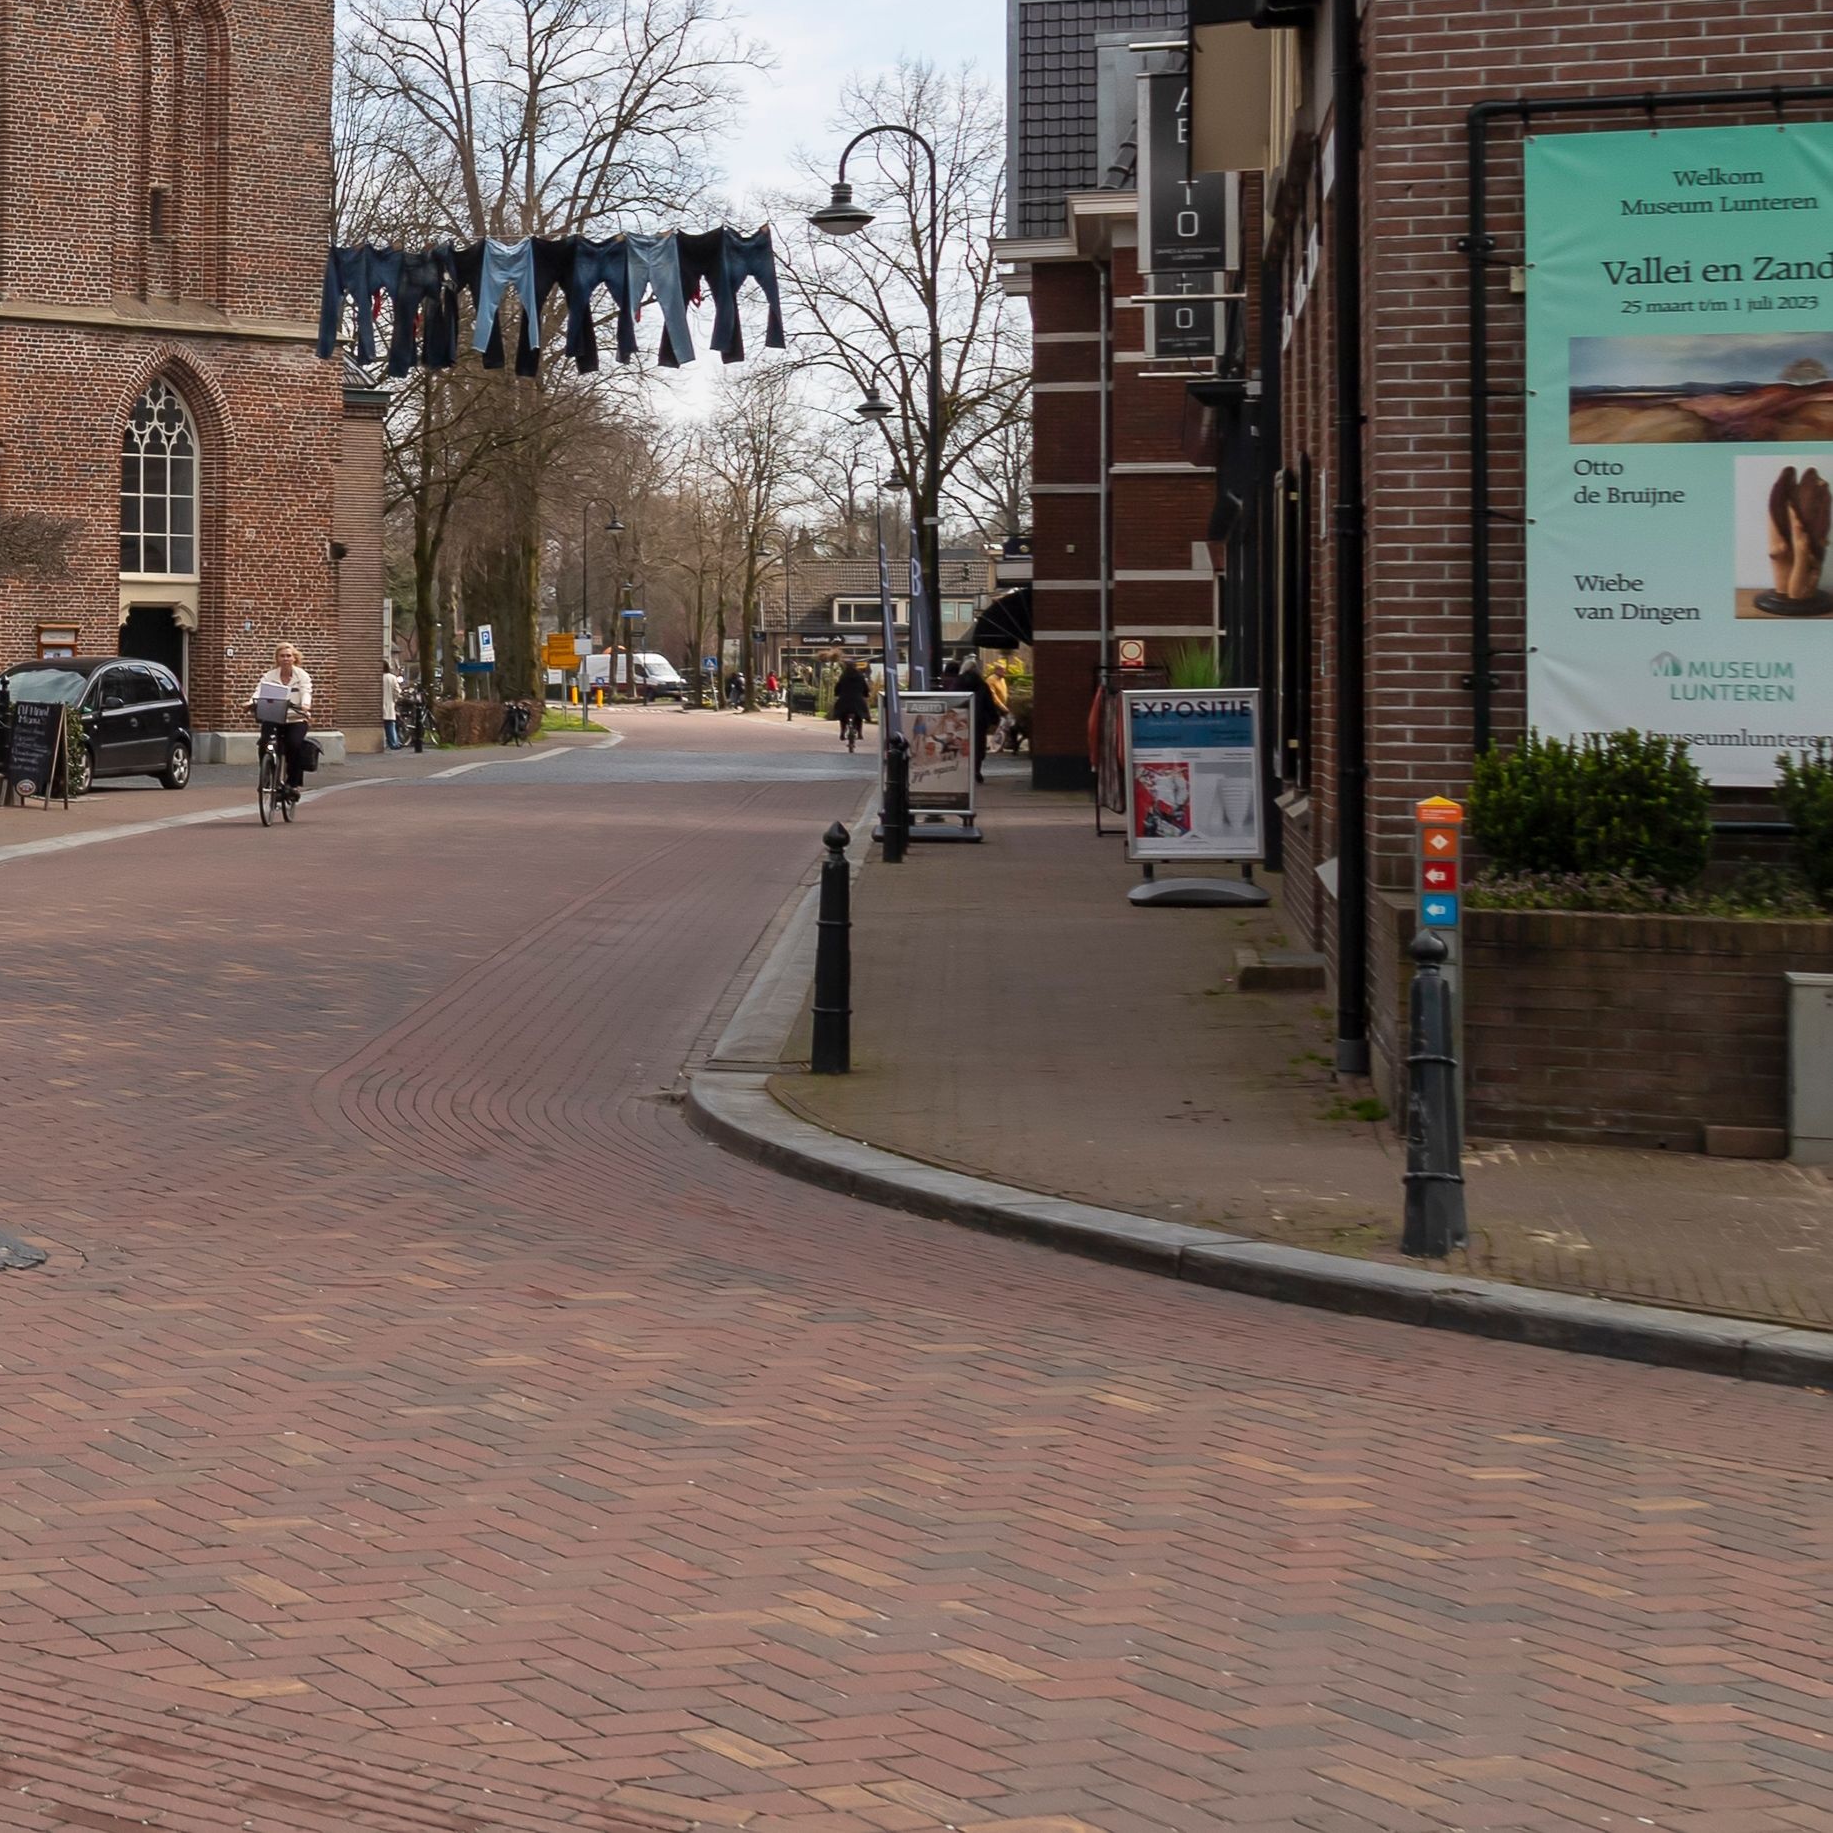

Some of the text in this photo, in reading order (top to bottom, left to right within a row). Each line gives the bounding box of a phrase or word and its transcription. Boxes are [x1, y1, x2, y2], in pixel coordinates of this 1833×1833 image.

[1672, 167, 1765, 187] Welkom
[1621, 195, 1819, 216] Museum Lunteren
[1601, 256, 1693, 286] Vallei
[1702, 261, 1745, 283] en
[1621, 295, 1820, 315] 25 maart t/m 1 juli 2023
[1574, 459, 1624, 476] Otto
[1574, 485, 1686, 508] de Bruijne
[1573, 574, 1644, 592] Wiebe
[1573, 603, 1701, 625] van Dingen
[1688, 661, 1794, 679] MUSEUM
[1670, 683, 1795, 702] LUNTEREN
[1130, 700, 1251, 719] EXPOSITIE
